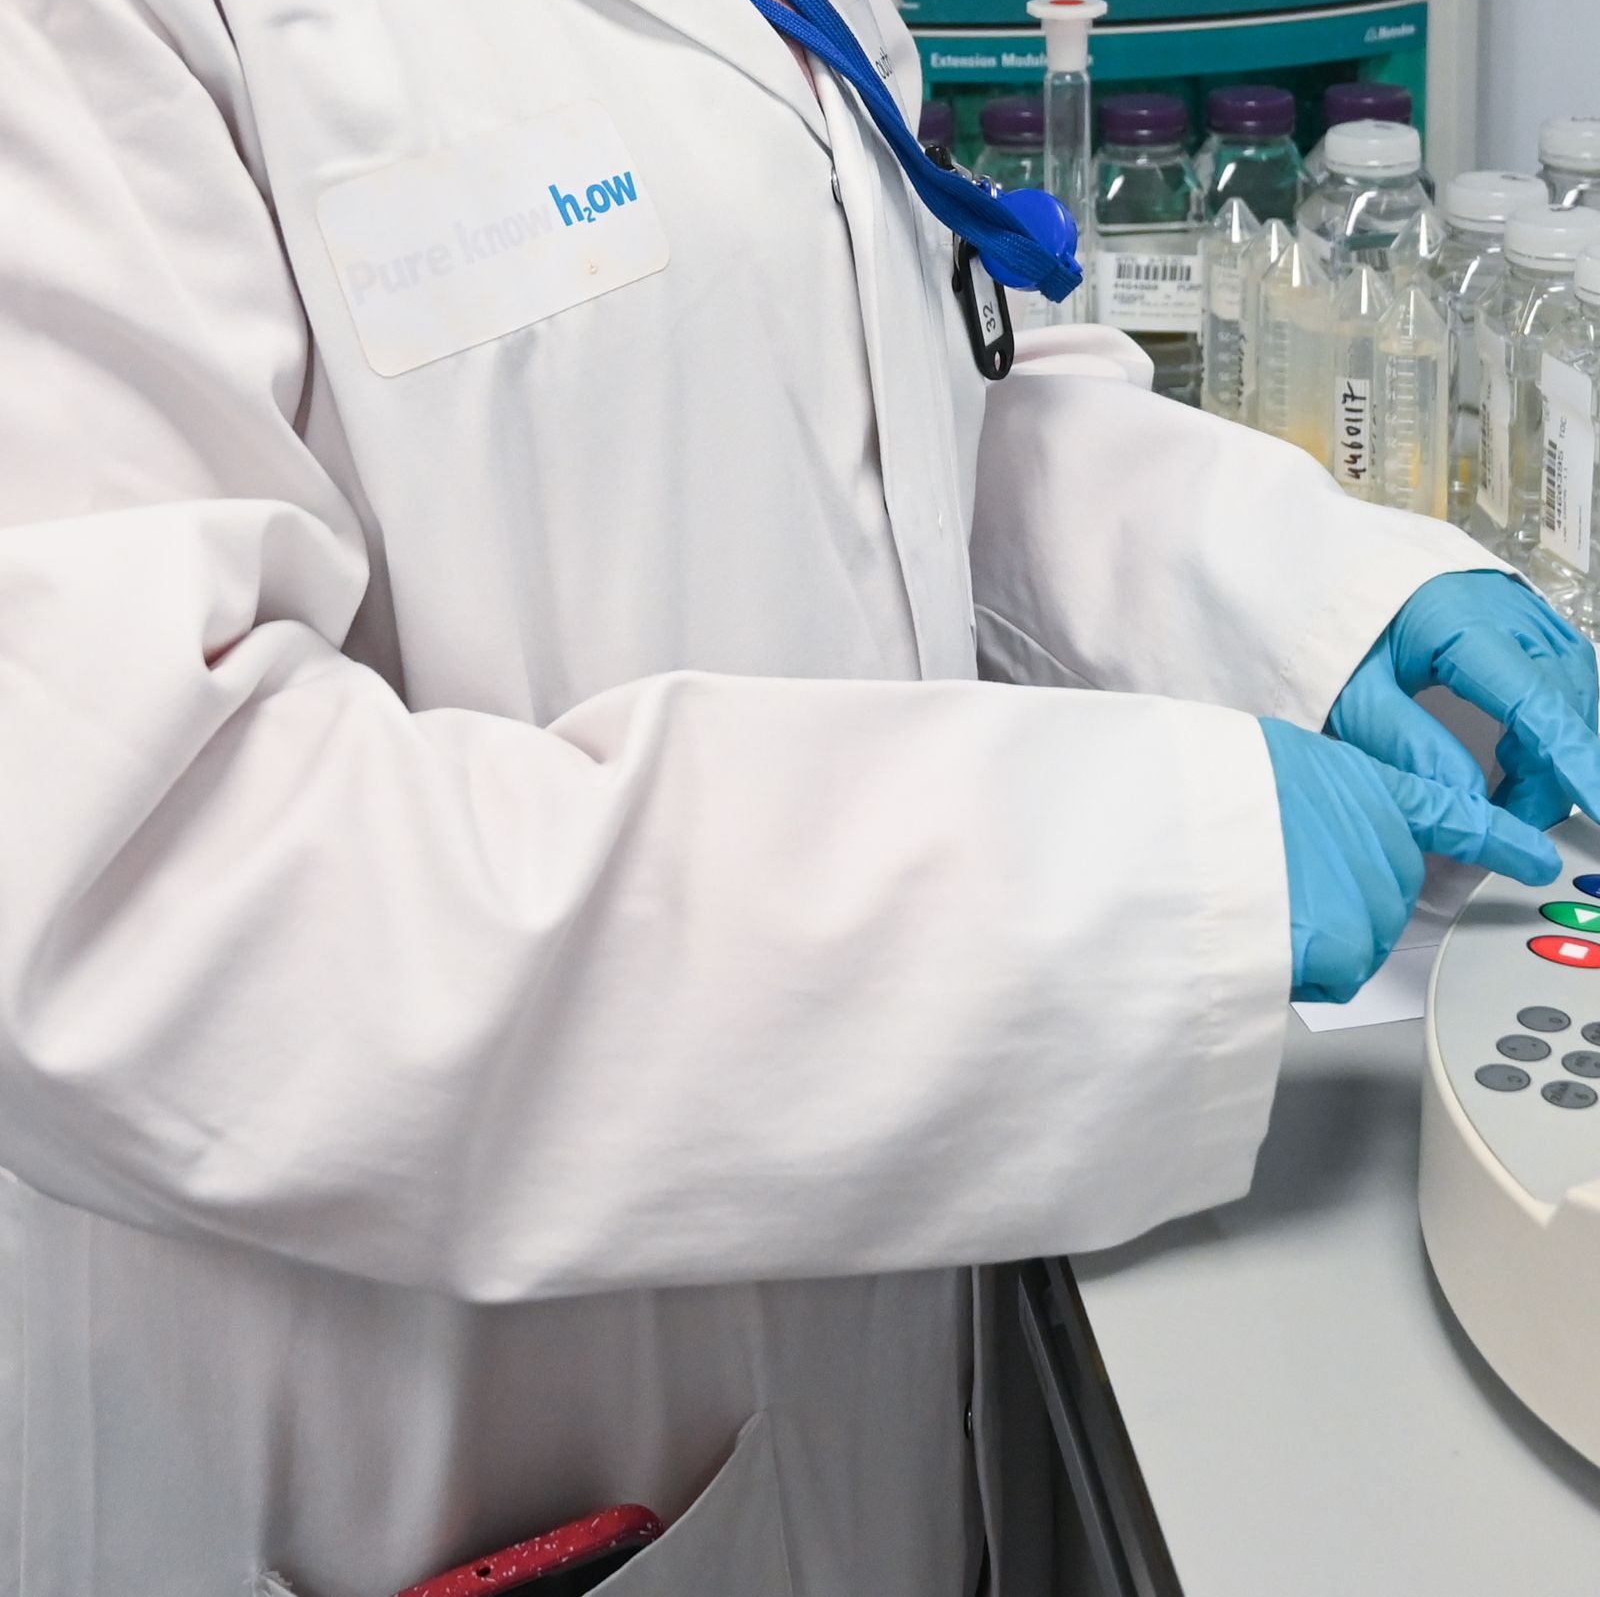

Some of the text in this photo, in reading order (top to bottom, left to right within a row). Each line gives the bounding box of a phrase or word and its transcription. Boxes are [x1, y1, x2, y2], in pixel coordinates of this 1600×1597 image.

[930, 52, 997, 68] Extension
[347, 244, 454, 306] Pure
[982, 300, 997, 333] 32
[1342, 380, 1368, 481] 4460117
[1558, 417, 1568, 440] TOC
